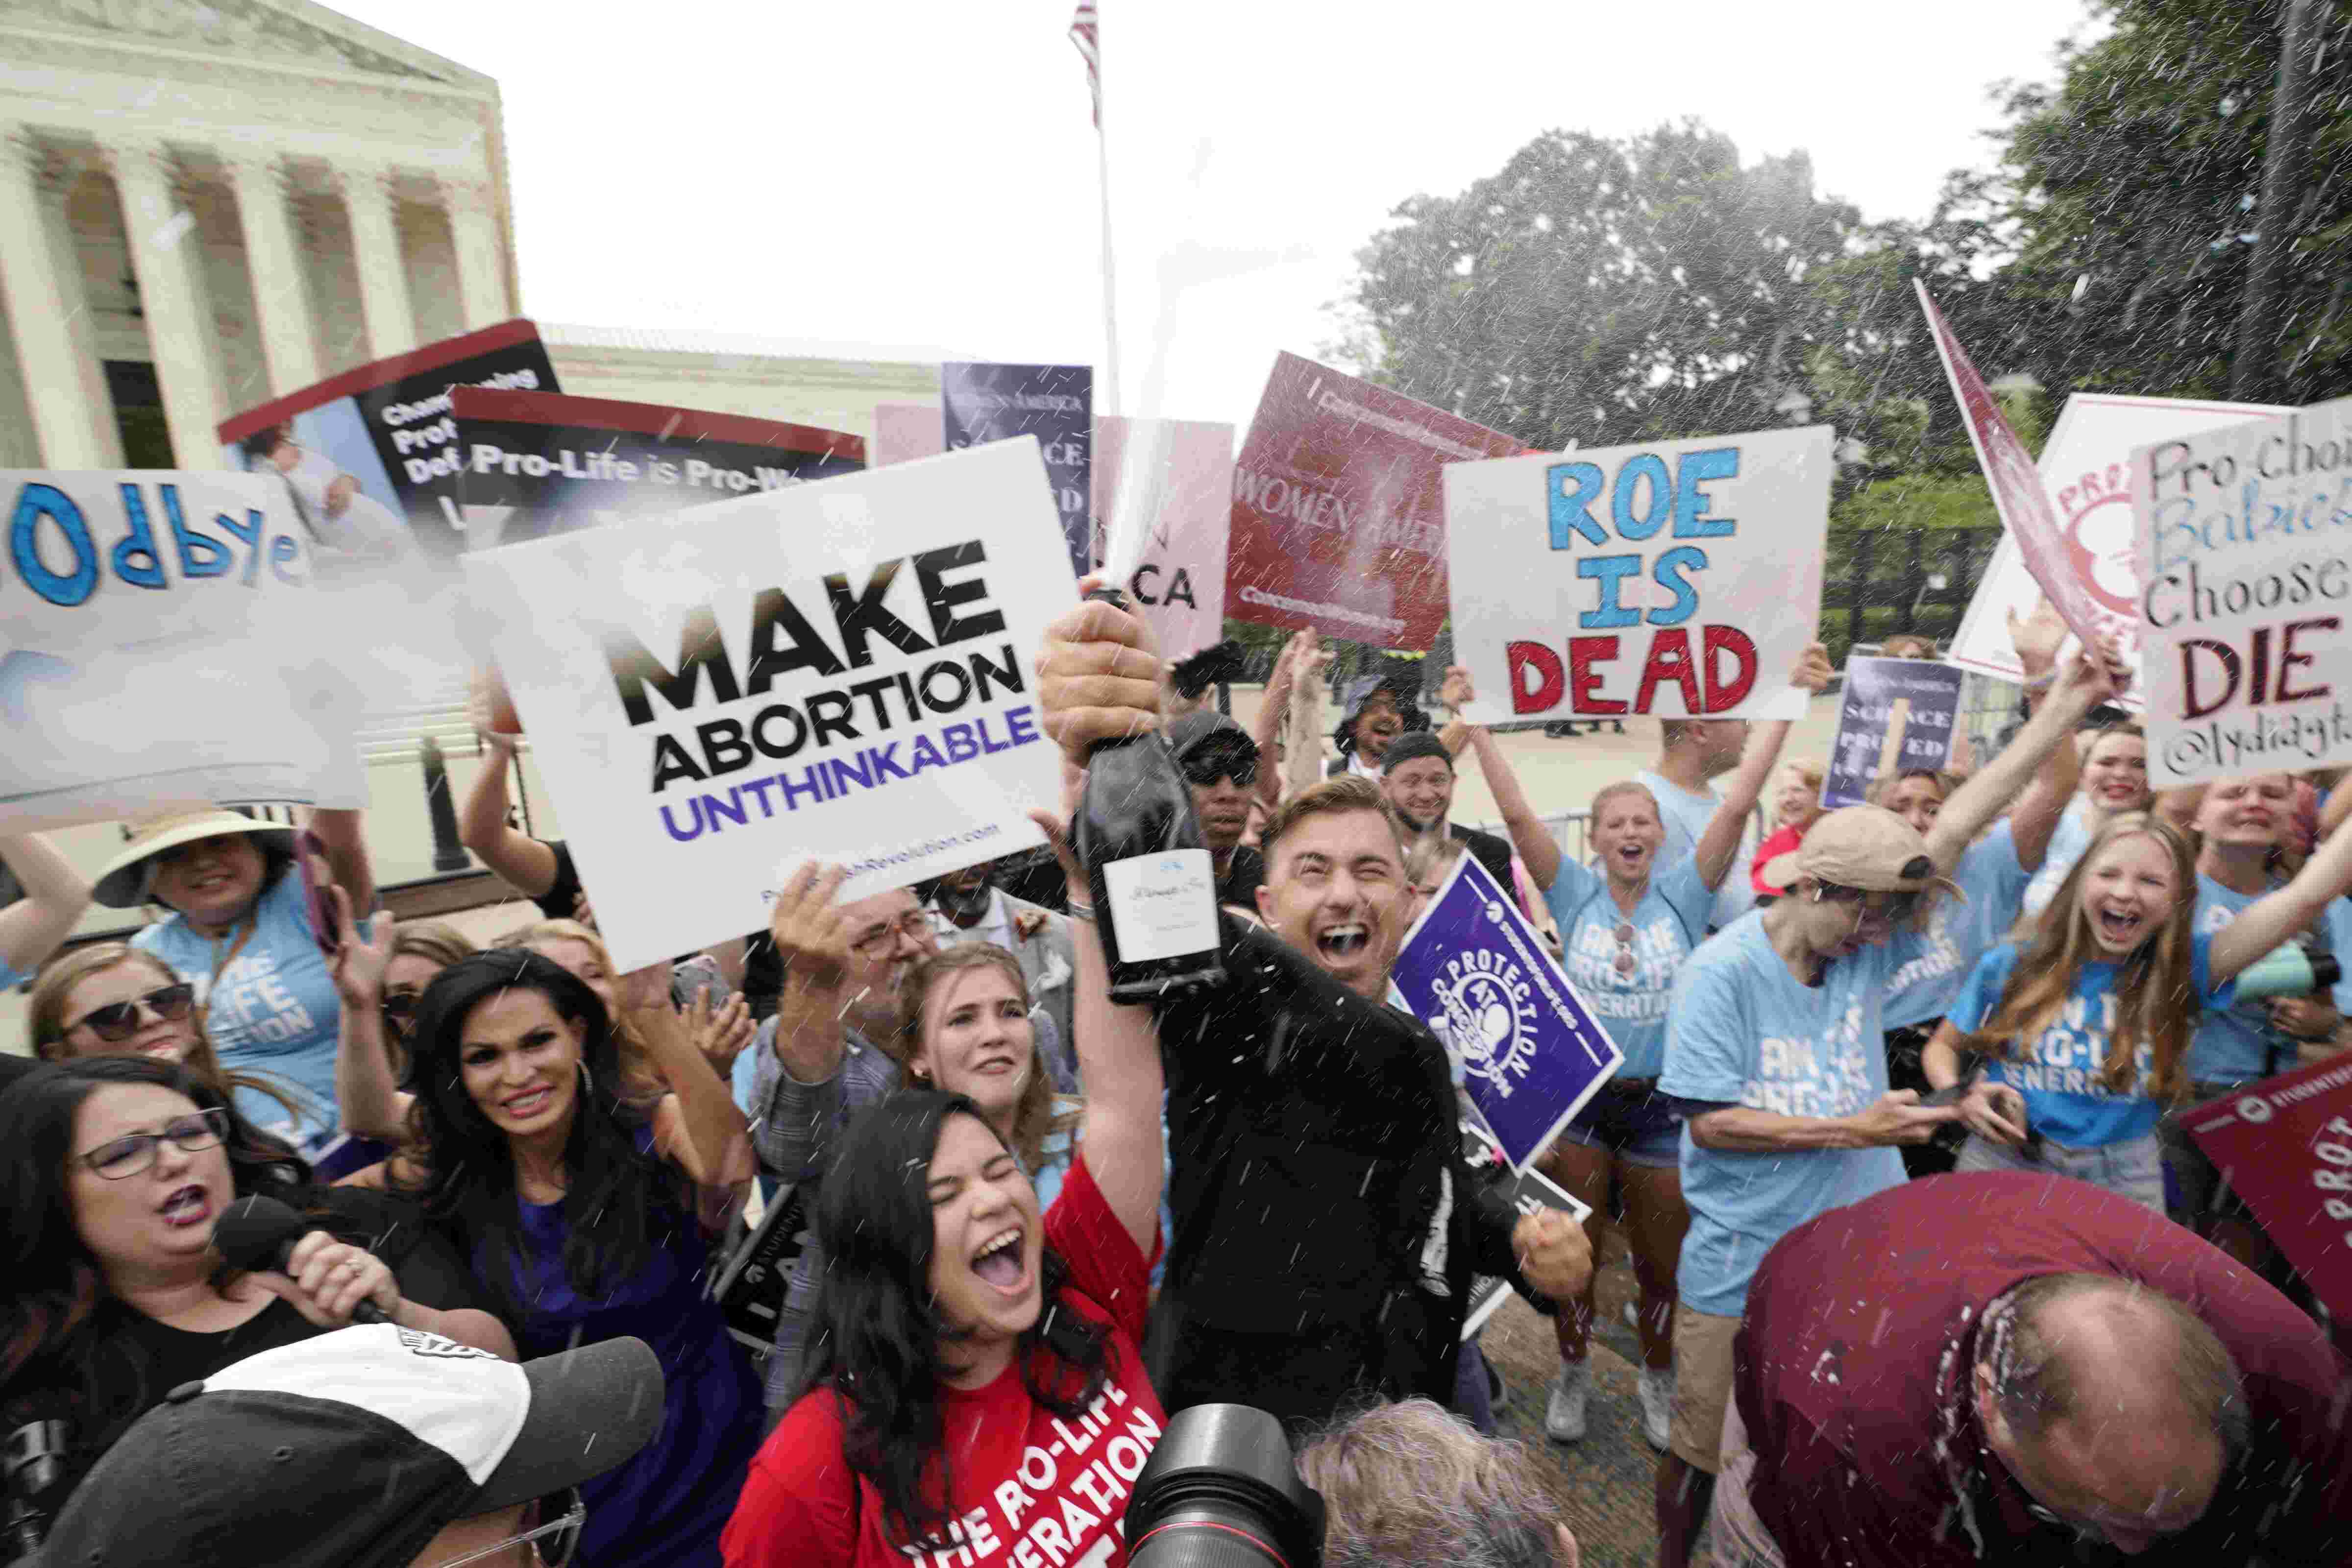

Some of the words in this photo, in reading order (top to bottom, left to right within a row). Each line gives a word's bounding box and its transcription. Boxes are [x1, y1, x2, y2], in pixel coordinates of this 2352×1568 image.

[469, 443, 638, 482] Pro-Life
[647, 456, 680, 487] is
[1544, 446, 1742, 551] ROE
[2148, 440, 2237, 503] Pro
[601, 539, 1006, 726] MAKE
[1576, 545, 1709, 629] IS
[2143, 558, 2350, 630] Choose
[651, 644, 1027, 793] ABORTION
[1506, 625, 1758, 715] DEAD
[2179, 616, 2342, 721] DIE
[660, 705, 1041, 842] UNTHINKABLE
[1431, 978, 1514, 1099] CONCEPTION
[1446, 948, 1539, 1079] PROTECTION
[1470, 979, 1498, 1011] AT
